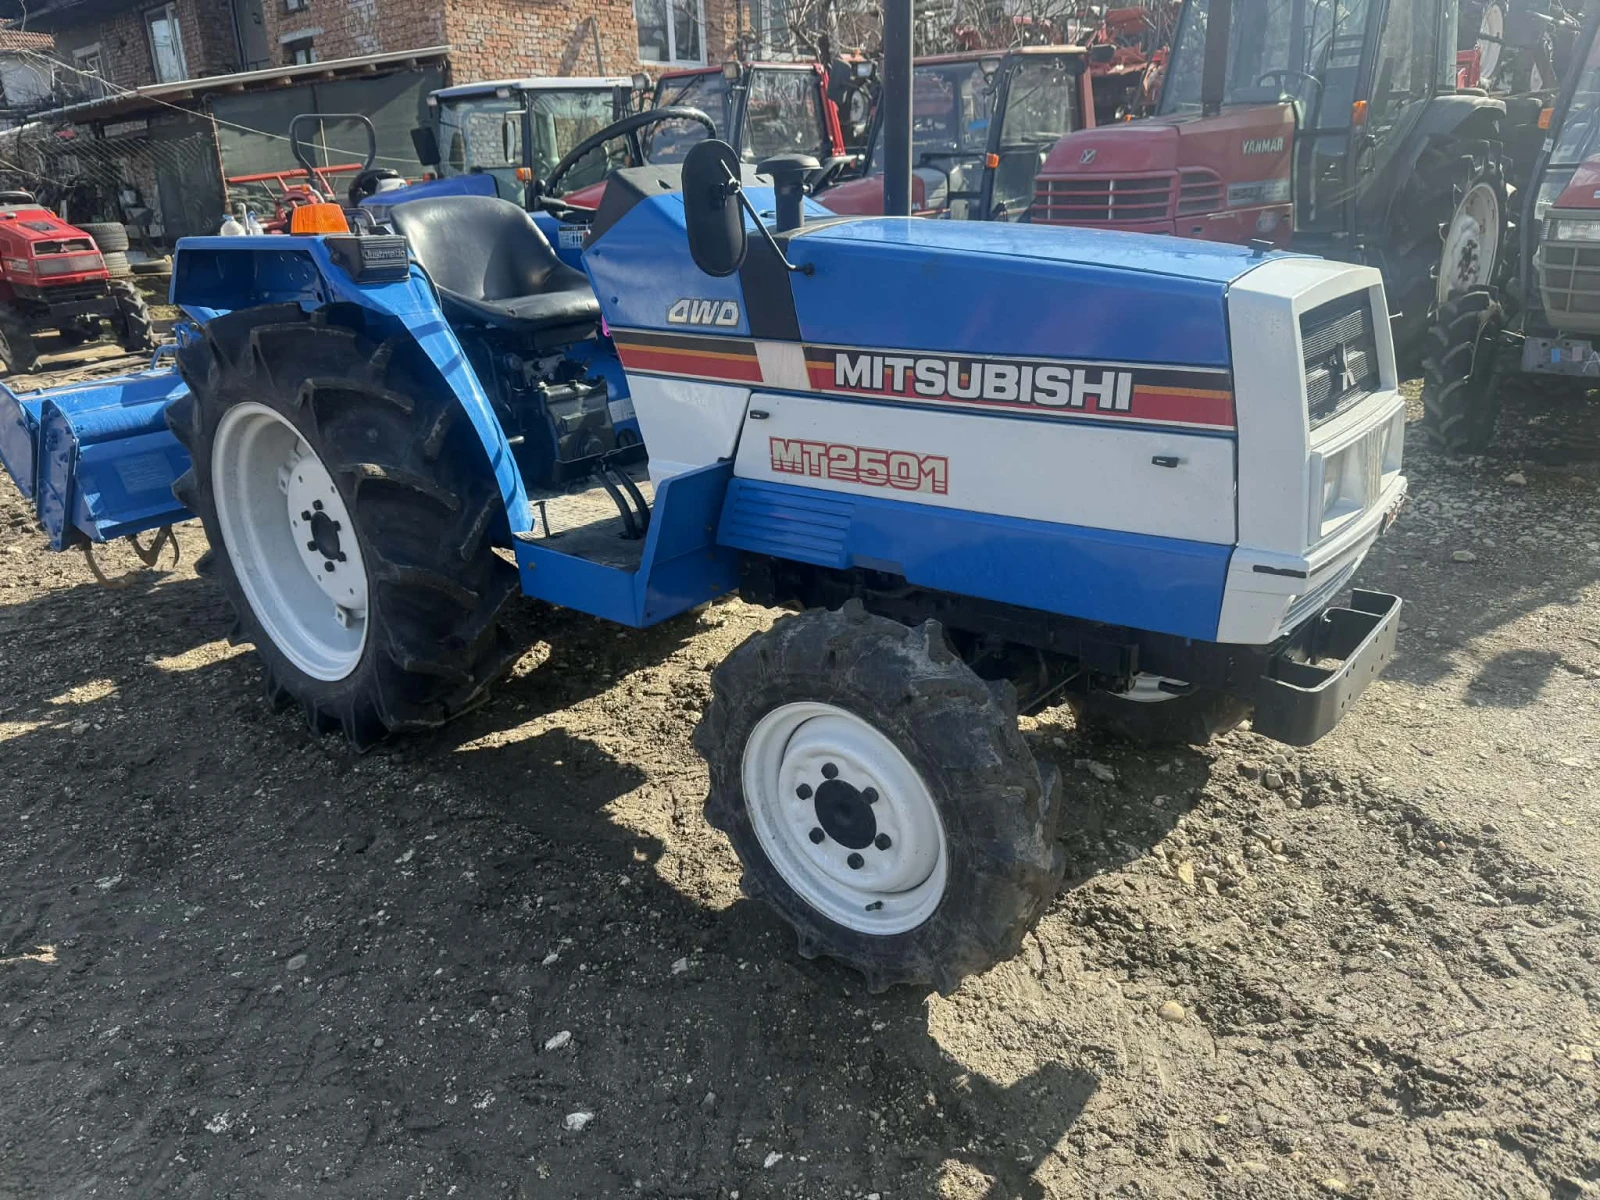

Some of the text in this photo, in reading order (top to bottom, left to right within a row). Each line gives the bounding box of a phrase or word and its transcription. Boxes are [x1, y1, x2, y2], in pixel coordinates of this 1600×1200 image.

[1242, 137, 1284, 155] YANMAR
[667, 299, 740, 326] 4WD
[834, 352, 1132, 411] MITSUBISHI
[769, 437, 949, 494] MT2501
